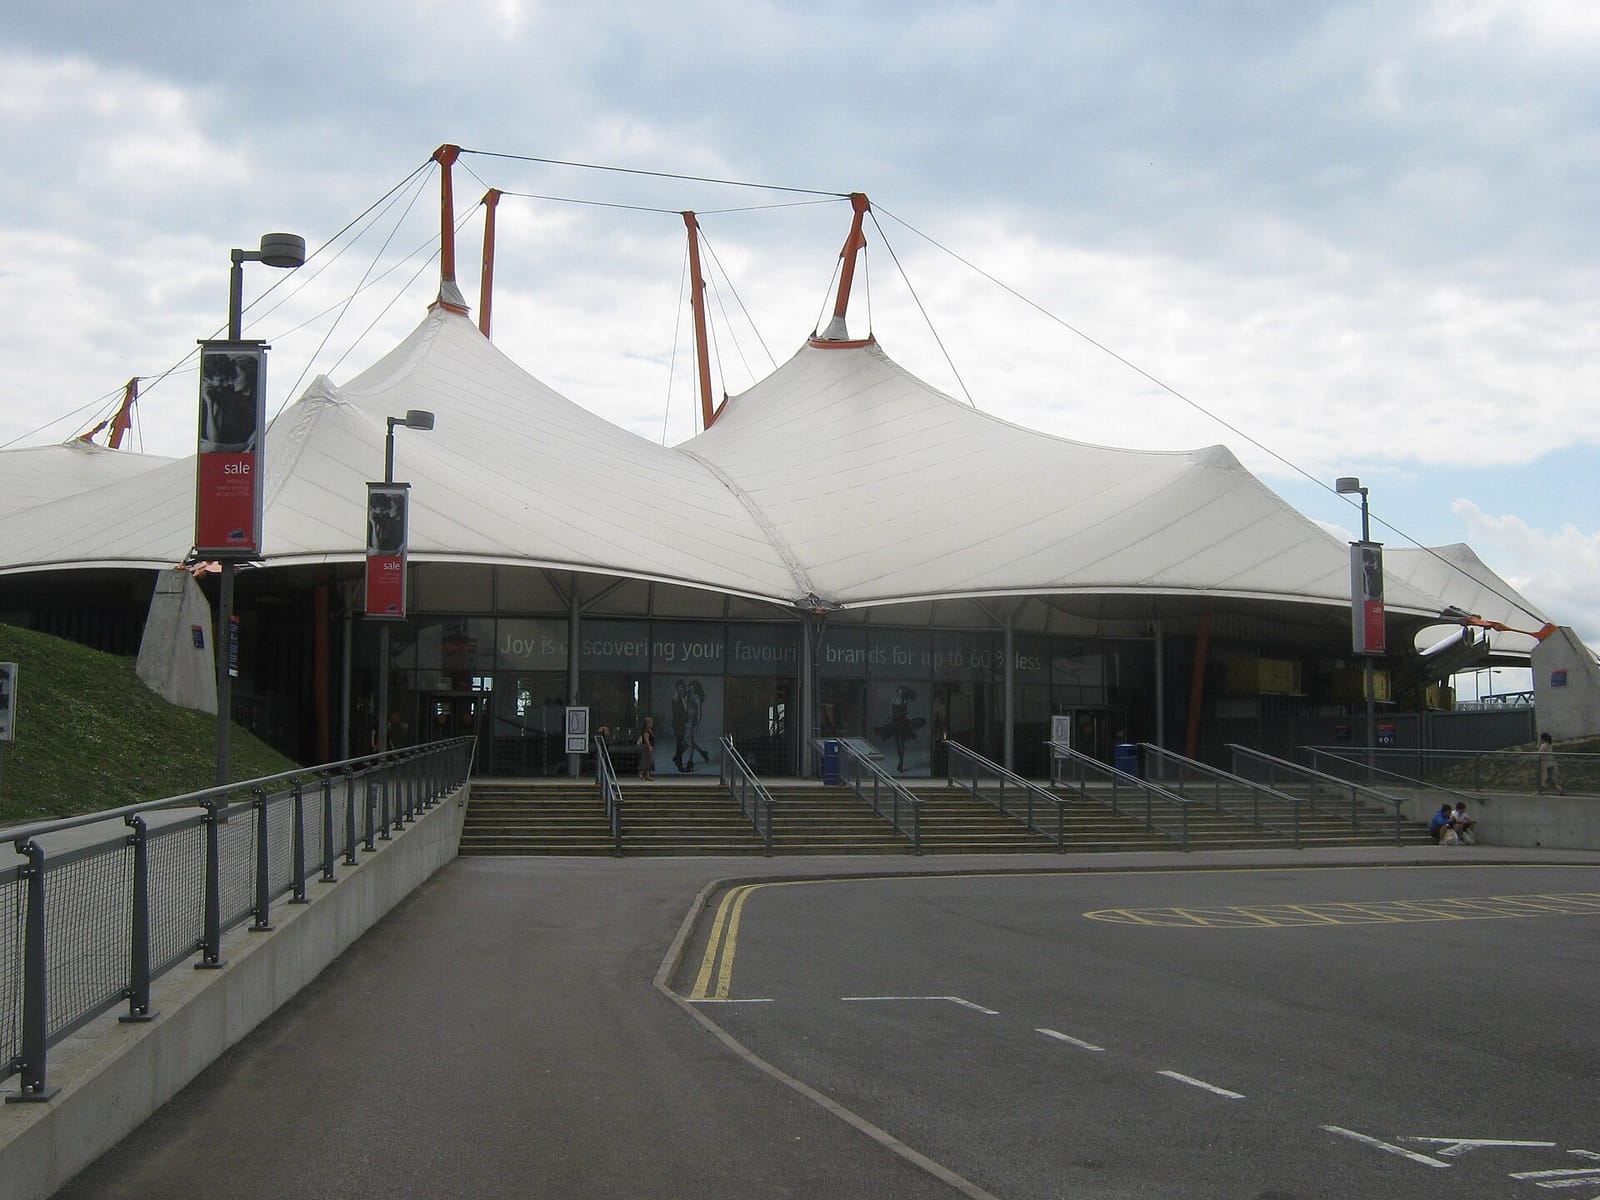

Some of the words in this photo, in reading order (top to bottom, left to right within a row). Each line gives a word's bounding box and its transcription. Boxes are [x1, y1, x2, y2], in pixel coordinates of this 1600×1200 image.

[224, 460, 250, 475] sale
[383, 561, 401, 570] sale
[500, 634, 535, 658] Joy
[541, 635, 554, 654] is
[681, 642, 723, 662] your
[826, 642, 888, 664] brands
[892, 645, 914, 665] for
[921, 649, 945, 671] up
[948, 648, 963, 667] to
[1015, 650, 1041, 670] less
